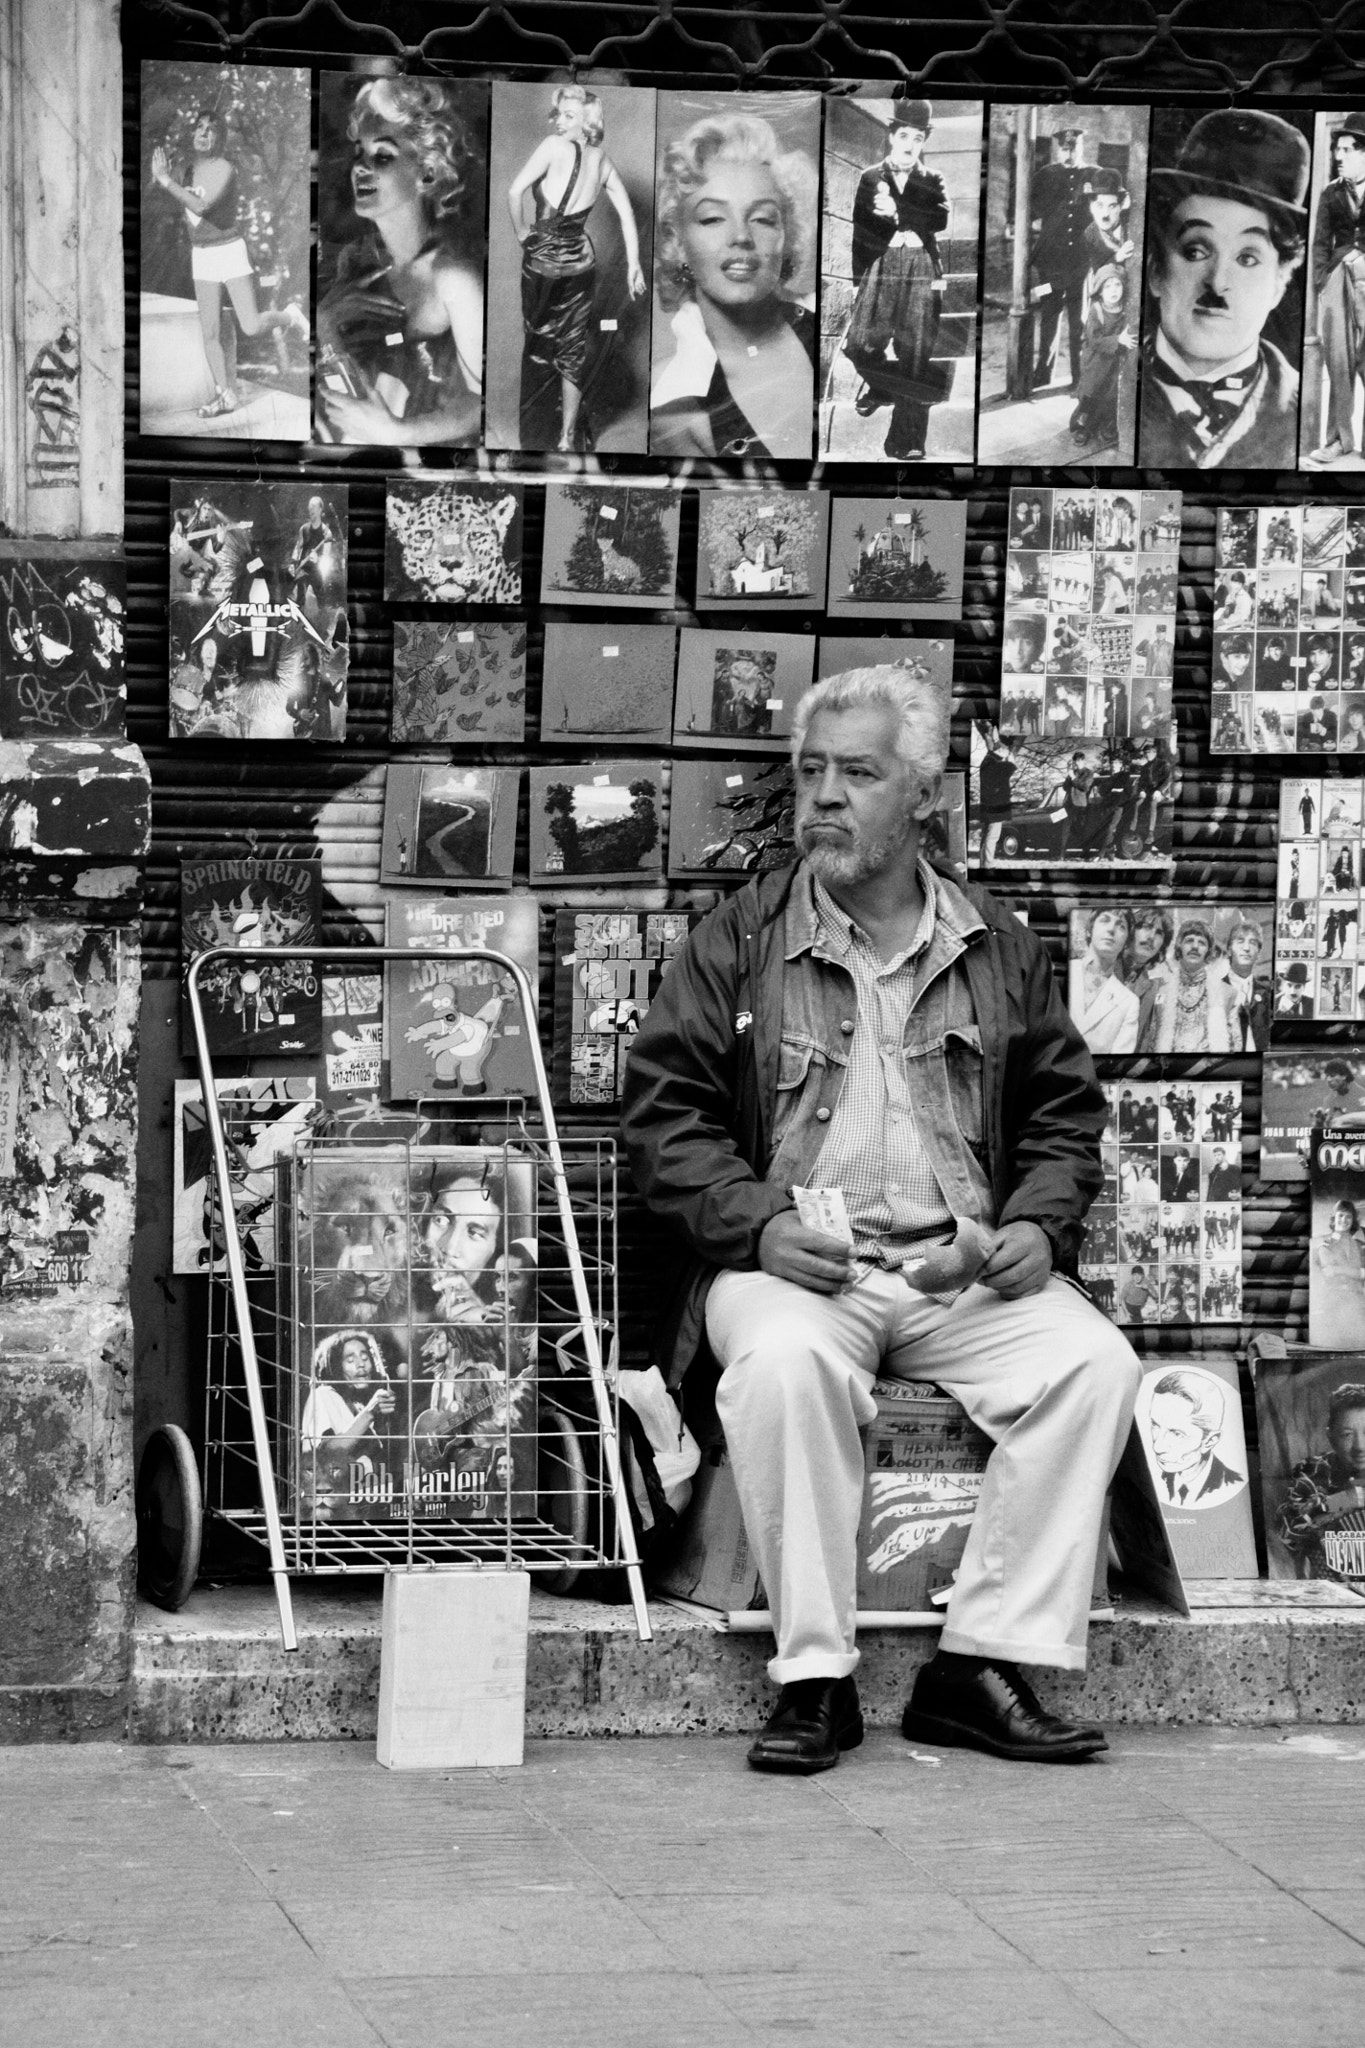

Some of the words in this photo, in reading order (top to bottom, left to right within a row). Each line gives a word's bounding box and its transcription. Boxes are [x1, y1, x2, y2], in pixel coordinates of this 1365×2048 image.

[181, 859, 311, 895] SPRINGFIELD
[404, 903, 436, 921] THE
[431, 910, 504, 932] DREADED
[574, 914, 642, 940] SOUL
[408, 960, 500, 993] ADMIRA
[572, 959, 656, 999] HOT
[350, 1062, 366, 1070] 645
[1264, 1127, 1285, 1138] JUAN
[1322, 1128, 1343, 1140] Una
[48, 1262, 69, 1282] 609
[348, 1462, 394, 1504] Bob
[402, 1461, 486, 1511] Marley
[1325, 1531, 1337, 1539] EL
